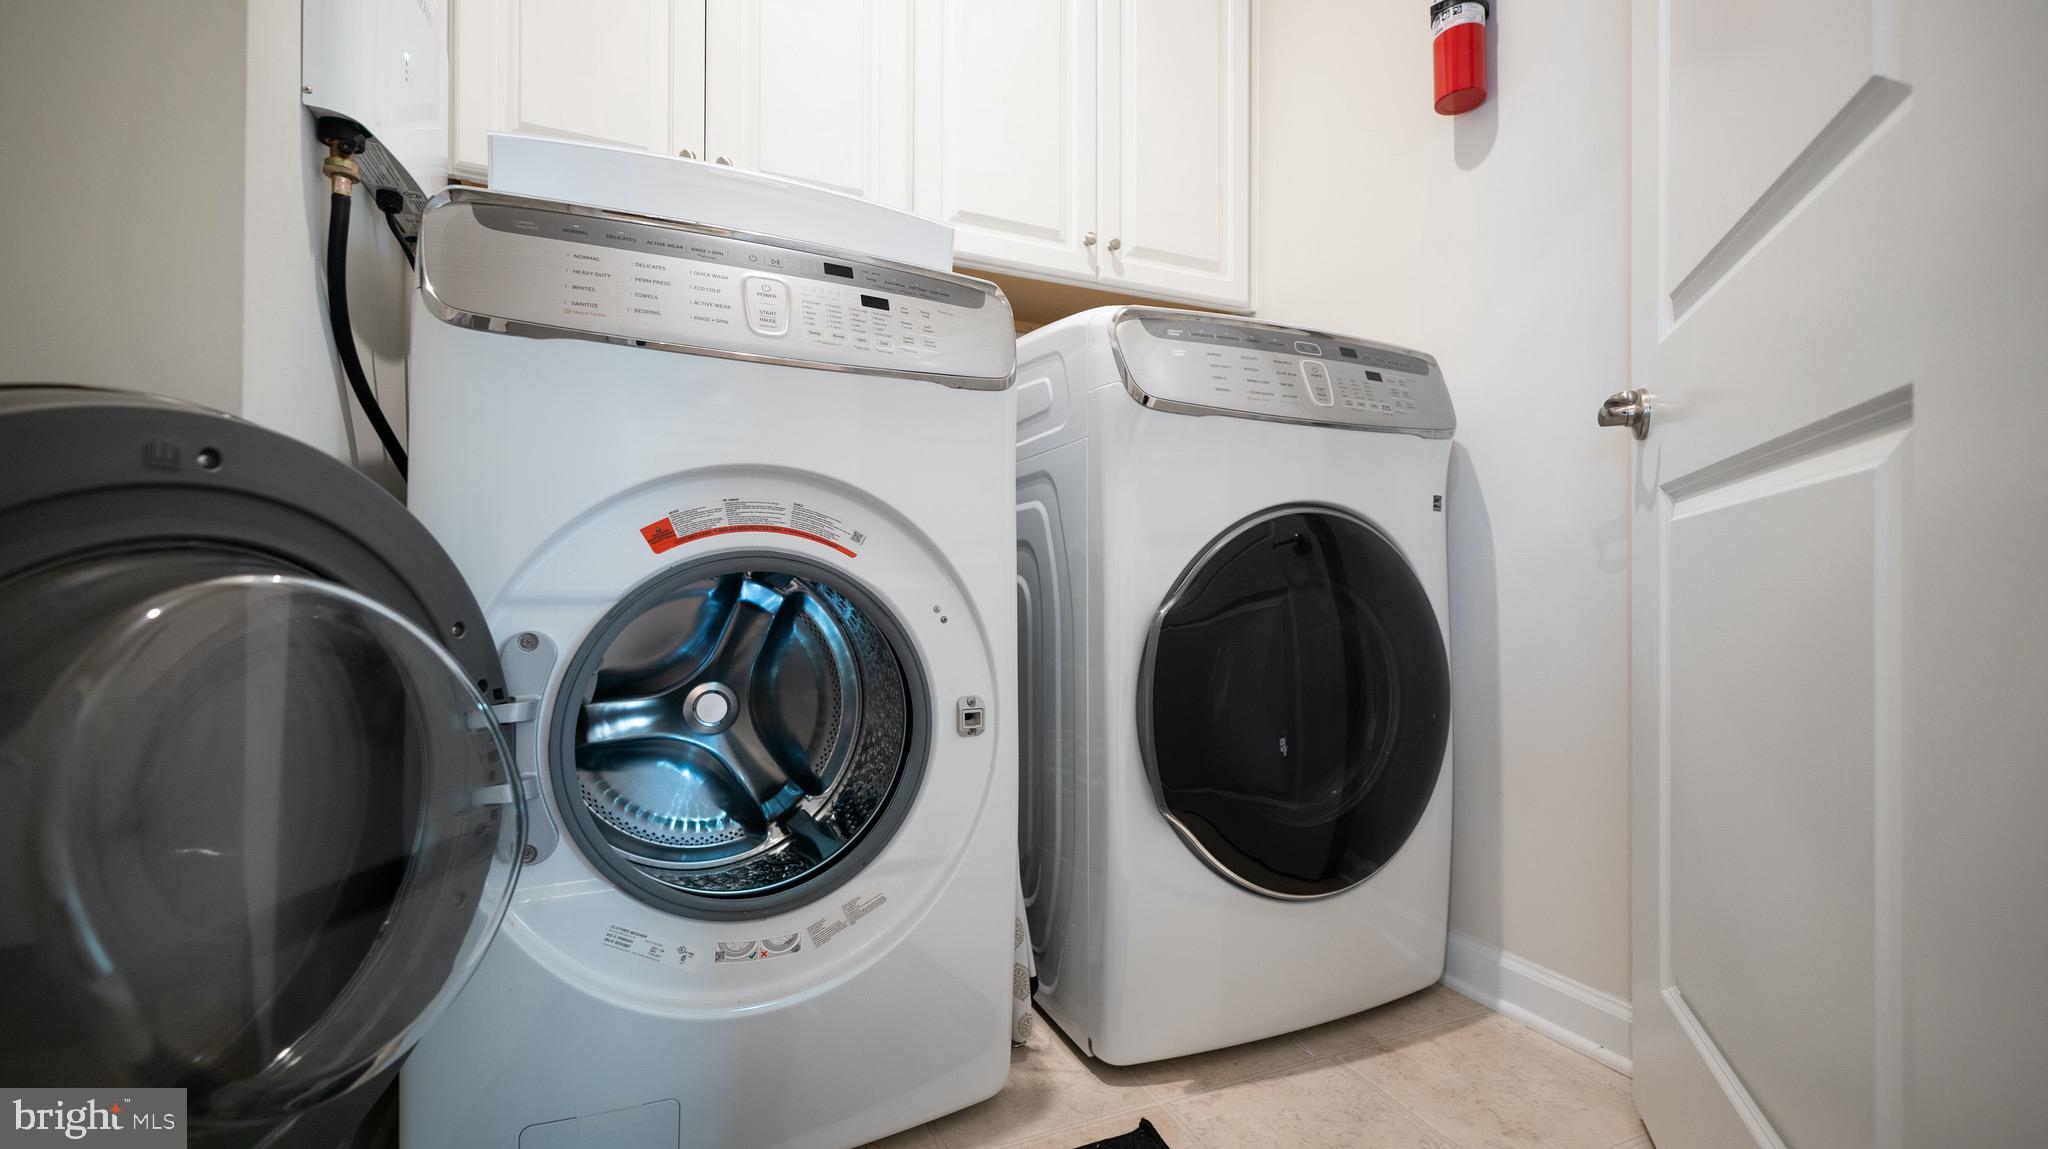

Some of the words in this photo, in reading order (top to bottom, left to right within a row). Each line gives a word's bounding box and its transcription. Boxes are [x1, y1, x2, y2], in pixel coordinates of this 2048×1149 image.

[562, 227, 589, 236] NORMAL
[606, 233, 637, 243] DELICATES
[646, 239, 666, 248] ACTIVE
[666, 242, 684, 250] WEAR
[573, 254, 600, 262] NORMAL
[635, 262, 666, 271] DELICATES
[572, 269, 594, 277] HEAVY
[693, 270, 711, 278] QUICK
[652, 279, 671, 287] PRESS
[572, 284, 596, 293] WHITES
[634, 292, 659, 300] TOWELS
[570, 301, 600, 309] SANITIZE
[693, 300, 713, 308] ACTIVE
[634, 308, 662, 316] BEDDING
[759, 309, 777, 317] START
[693, 315, 711, 323] RINSE
